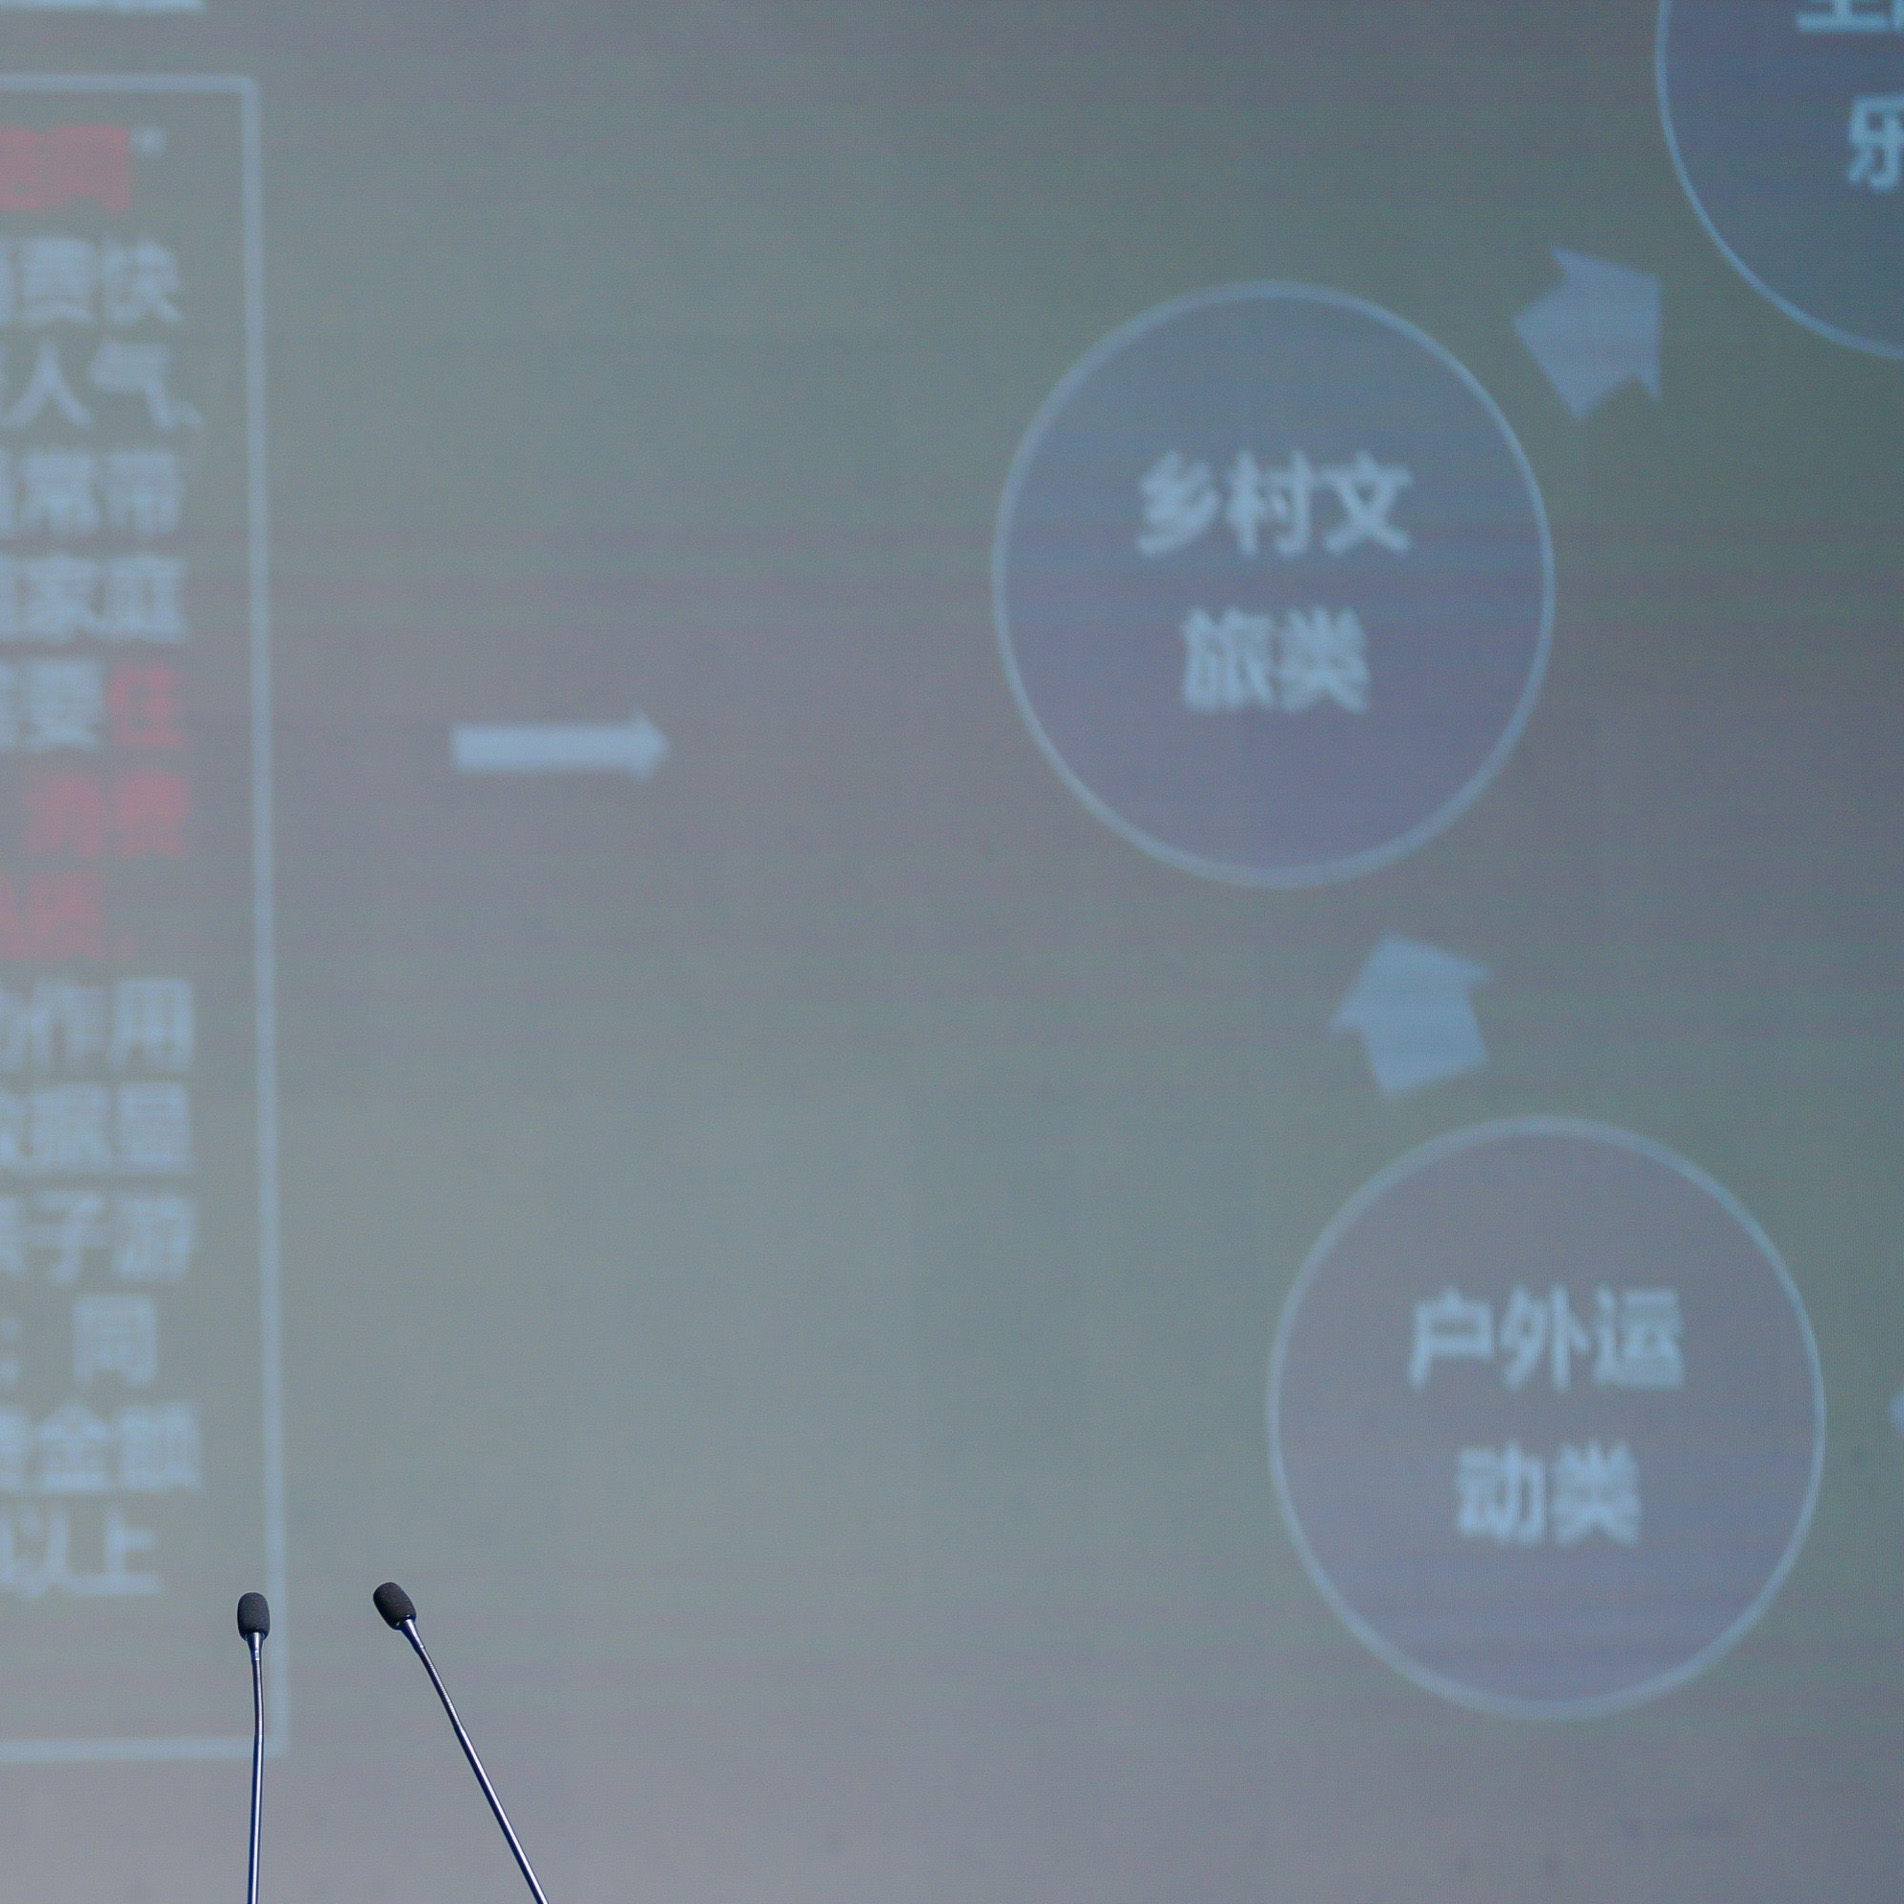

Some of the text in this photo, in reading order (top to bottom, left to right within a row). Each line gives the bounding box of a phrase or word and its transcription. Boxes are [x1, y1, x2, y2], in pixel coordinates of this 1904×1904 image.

[1133, 449, 1414, 560] 乡村文
[1178, 606, 1373, 714] 旅类
[1406, 1283, 1685, 1394] 户外运
[1453, 1440, 1641, 1548] 动类
